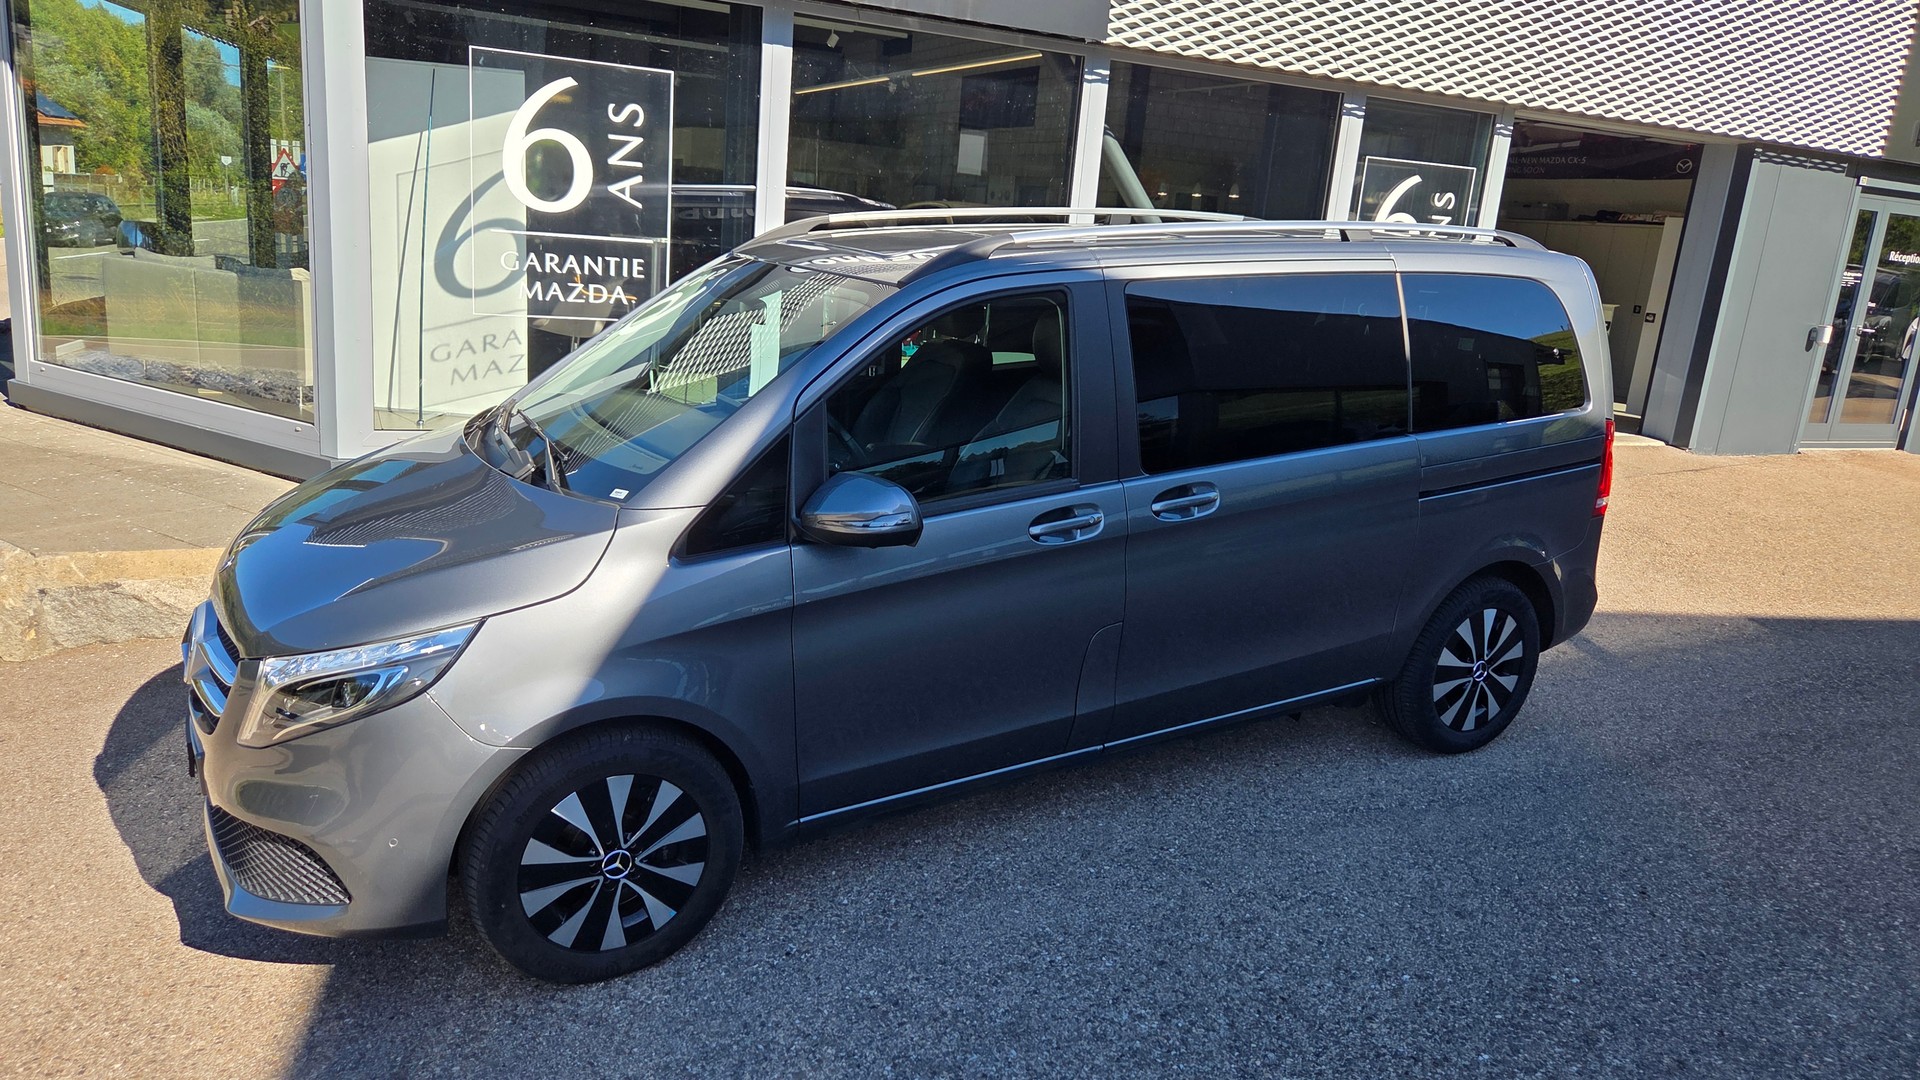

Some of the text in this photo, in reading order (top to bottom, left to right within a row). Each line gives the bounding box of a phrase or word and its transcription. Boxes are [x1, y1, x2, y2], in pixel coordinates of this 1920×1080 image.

[502, 76, 594, 213] 6
[607, 103, 645, 209] ANS
[1539, 156, 1566, 164] MAZDA
[1567, 156, 1587, 164] CX-5
[500, 251, 646, 279] GARANTIE
[1888, 250, 1920, 265] Réceptio
